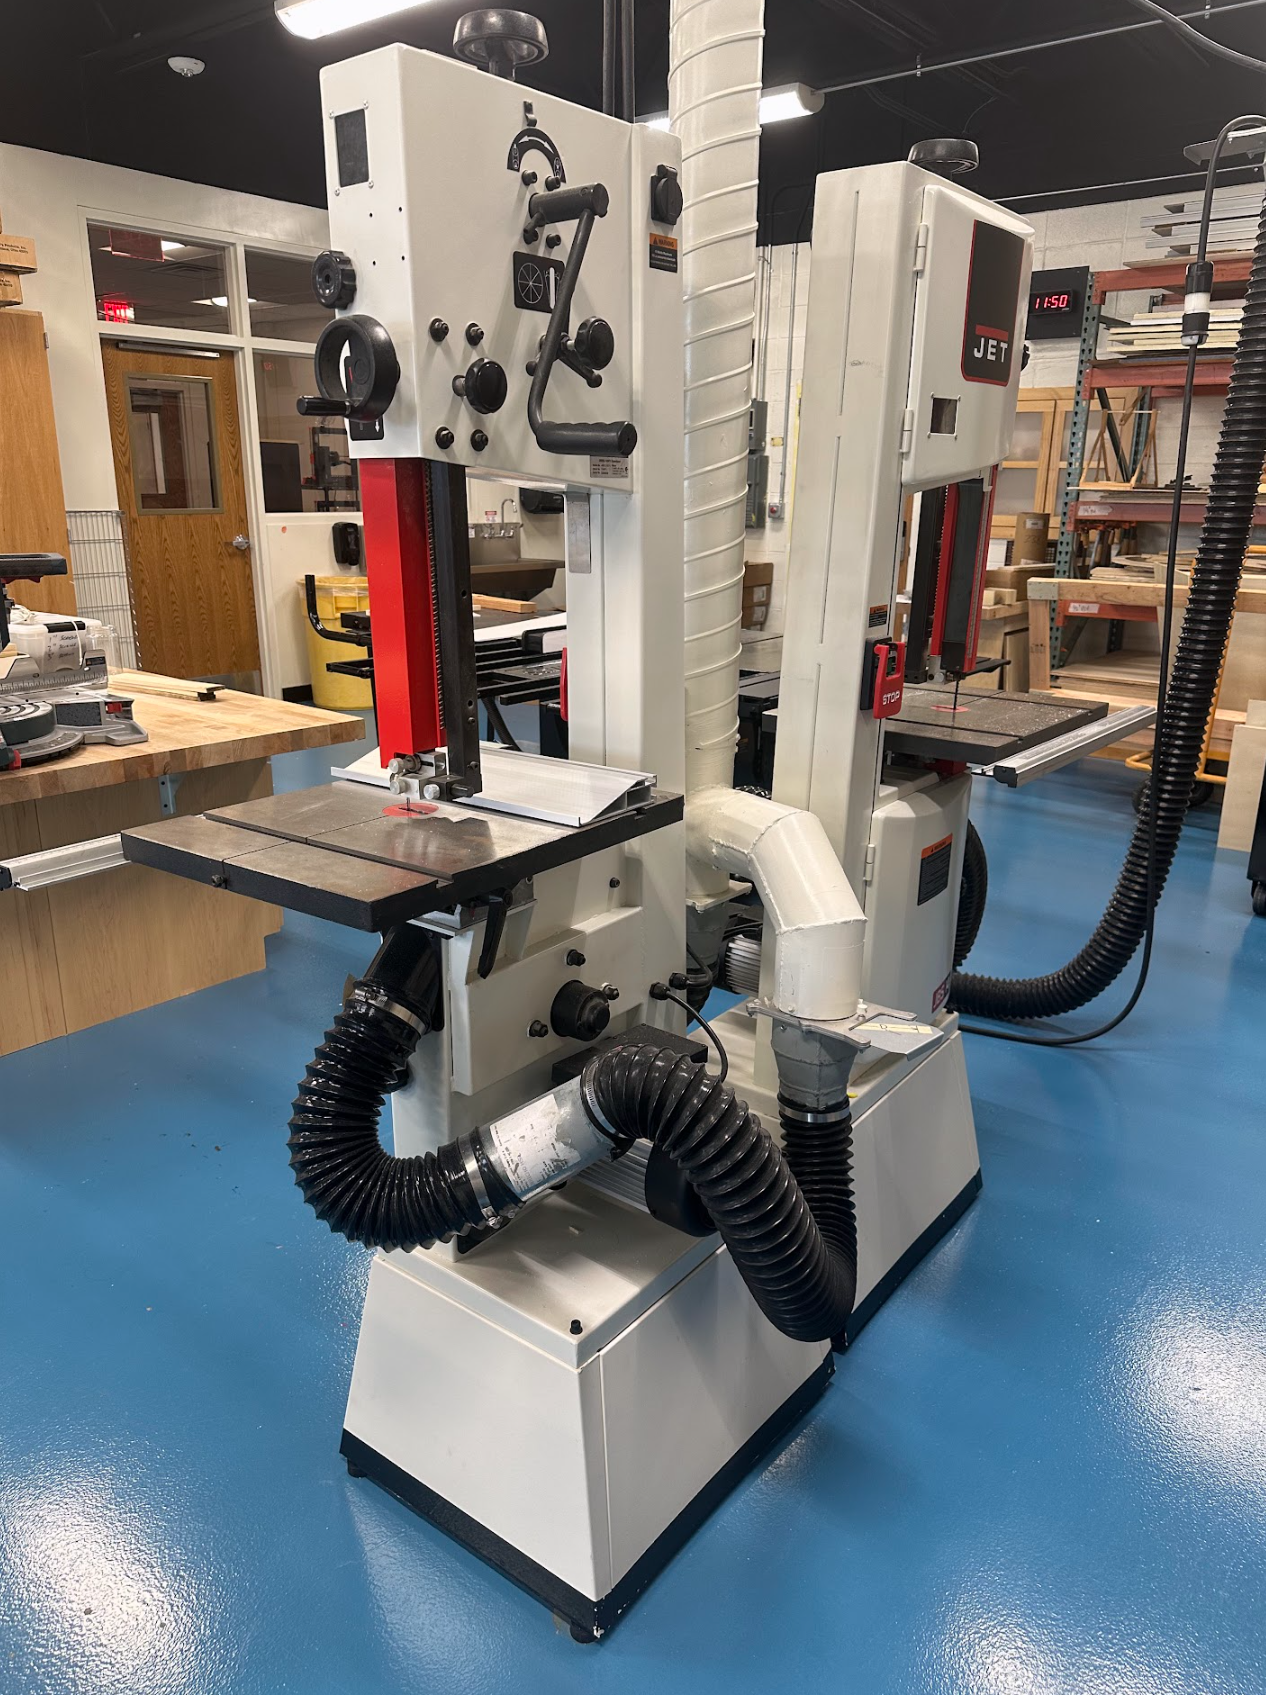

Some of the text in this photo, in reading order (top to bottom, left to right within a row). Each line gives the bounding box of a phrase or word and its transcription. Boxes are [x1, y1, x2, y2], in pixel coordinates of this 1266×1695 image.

[1035, 295, 1068, 309] 11:50
[974, 337, 1008, 363] JET
[882, 690, 900, 705] STOP
